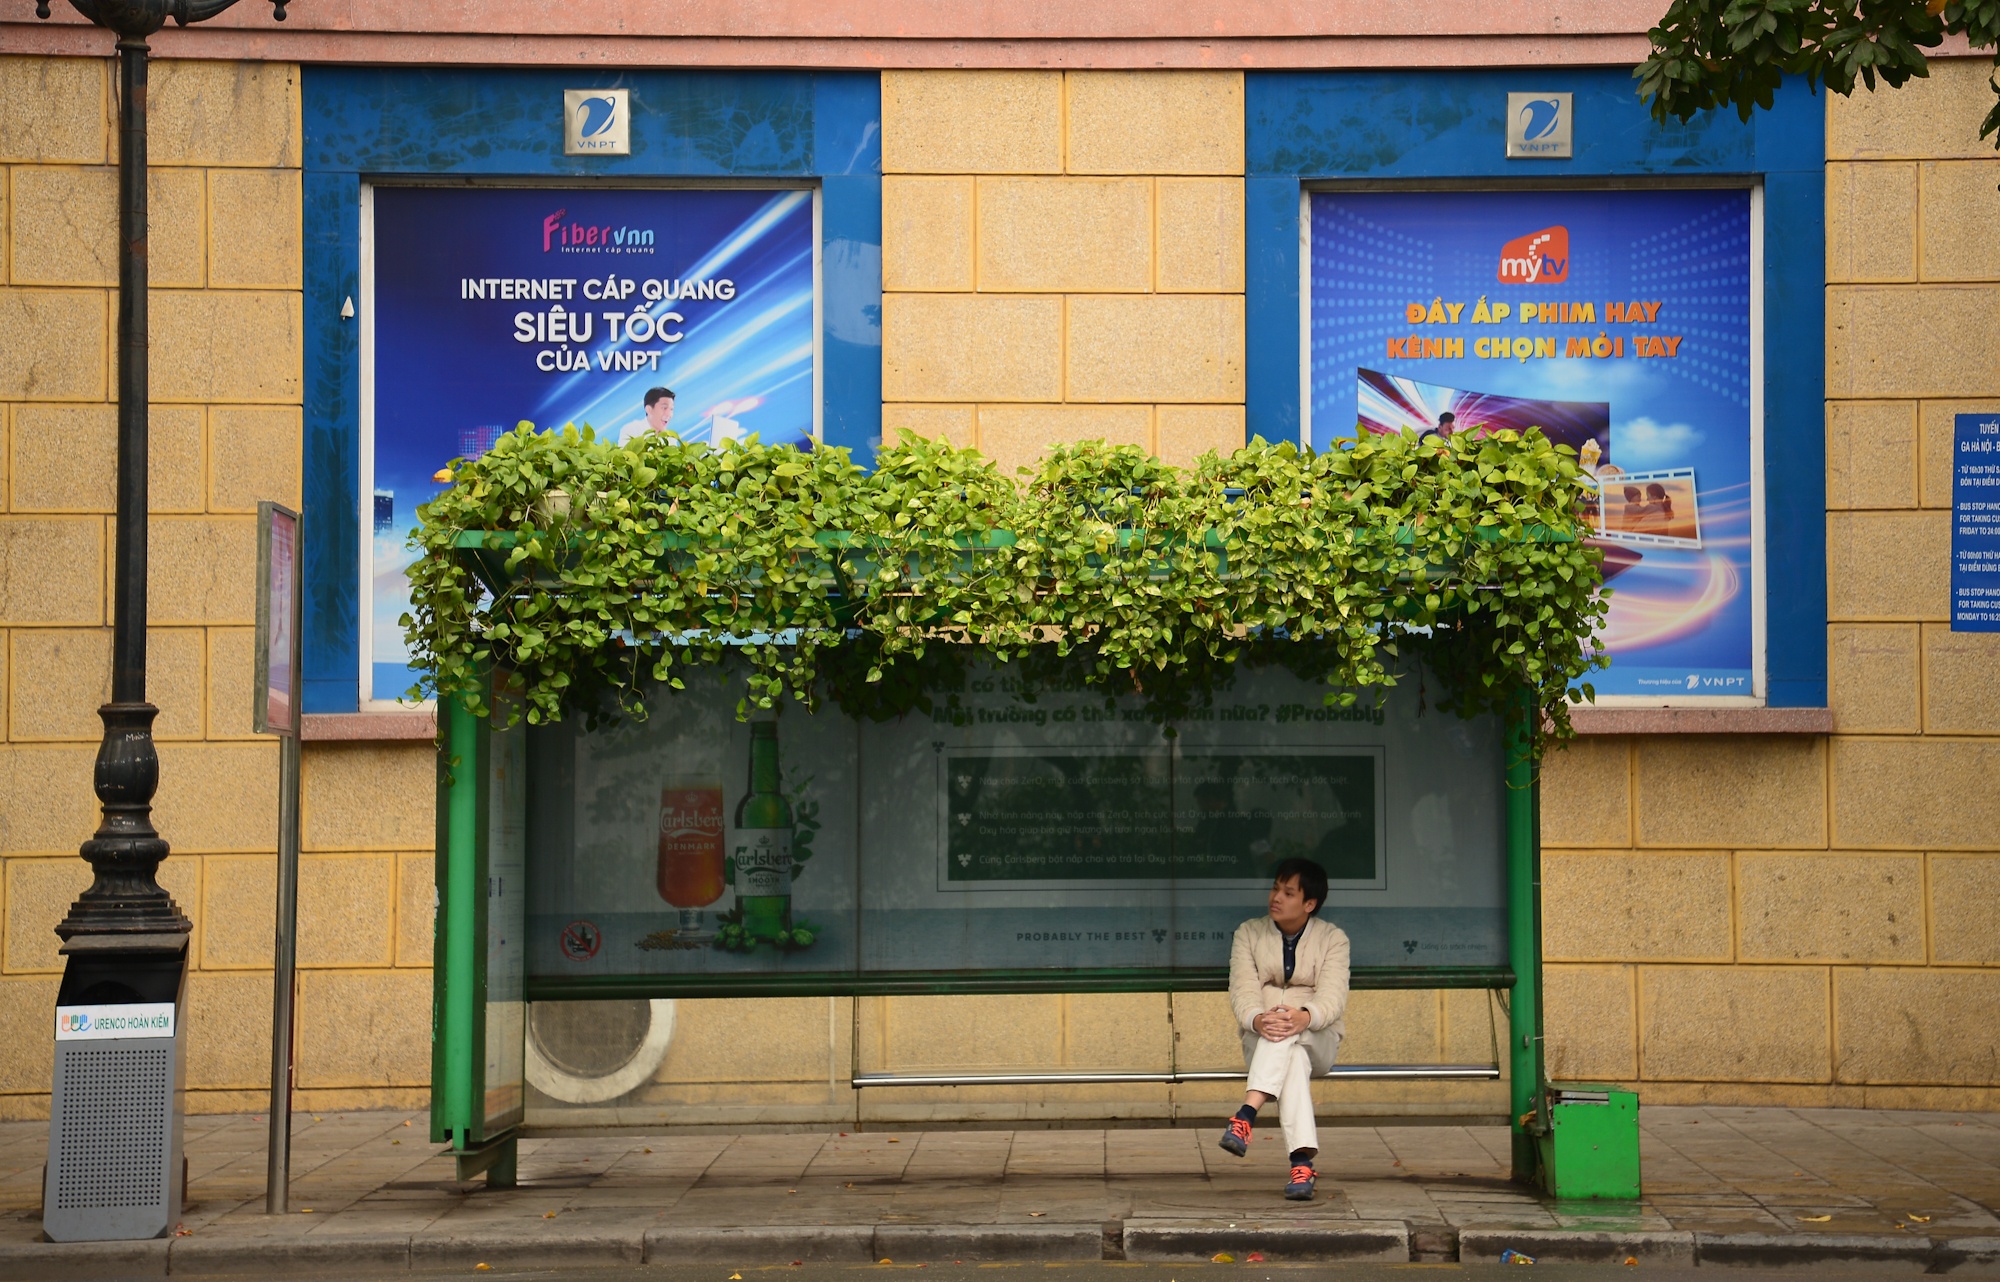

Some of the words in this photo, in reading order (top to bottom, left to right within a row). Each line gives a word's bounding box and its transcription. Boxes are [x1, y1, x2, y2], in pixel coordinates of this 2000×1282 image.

[577, 141, 616, 149] VNPT
[1519, 143, 1559, 152] VNPT
[605, 246, 622, 255] cáp
[626, 247, 655, 255] quang
[1502, 252, 1566, 283] mytv
[461, 279, 578, 301] INTERNET
[583, 273, 636, 301] CÁP
[642, 279, 736, 302] QUANG
[1405, 296, 1466, 325] ĐẦY
[1471, 295, 1511, 325] ẮP
[1520, 302, 1597, 325] PHIM
[1605, 301, 1662, 325] HAY
[514, 304, 594, 344] SIÊU
[603, 301, 685, 344] TỐC
[1387, 334, 1465, 360] KÊNH
[1473, 337, 1557, 365] CHỌN
[1566, 331, 1624, 360] MỎI
[1633, 336, 1684, 360] TAY
[536, 344, 592, 372] CỦA
[597, 351, 662, 372] VNPT
[1980, 420, 1999, 435] TUYẾN
[1961, 441, 1971, 453] GA
[1971, 438, 1981, 453] HÀ
[1981, 438, 1993, 455] NỘI
[1960, 502, 1971, 511] BUS
[1972, 502, 1986, 511] STOP
[1960, 514, 1971, 523] FOR
[1971, 514, 1991, 523] TAKING
[1959, 527, 1979, 535] FRIDAY
[1979, 526, 1987, 535] TO
[1958, 588, 1970, 597] BUS
[1970, 588, 1985, 597] STOP
[1958, 600, 1969, 609] FOR
[1970, 600, 1990, 609] TAKING
[1957, 612, 1980, 621] MONDAY
[1980, 612, 1988, 621] TO
[1703, 677, 1745, 687] VNPT
[978, 705, 1046, 727] trường
[1052, 704, 1076, 723] có
[1220, 703, 1270, 722] nữa?
[1275, 702, 1385, 727] #Probably
[668, 842, 716, 851] DENMARK
[1004, 855, 1046, 866] Carlsberg
[1085, 855, 1103, 864] chai
[1148, 854, 1166, 866] Oxy
[1016, 931, 1082, 942] PROBABLY
[1086, 931, 1108, 942] THE
[1115, 931, 1146, 942] BEST
[1175, 930, 1206, 942] BEER
[1212, 931, 1226, 942] IN
[94, 1017, 126, 1031] URENCO
[127, 1012, 149, 1030] HOÀN
[151, 1011, 169, 1029] KIẾM
